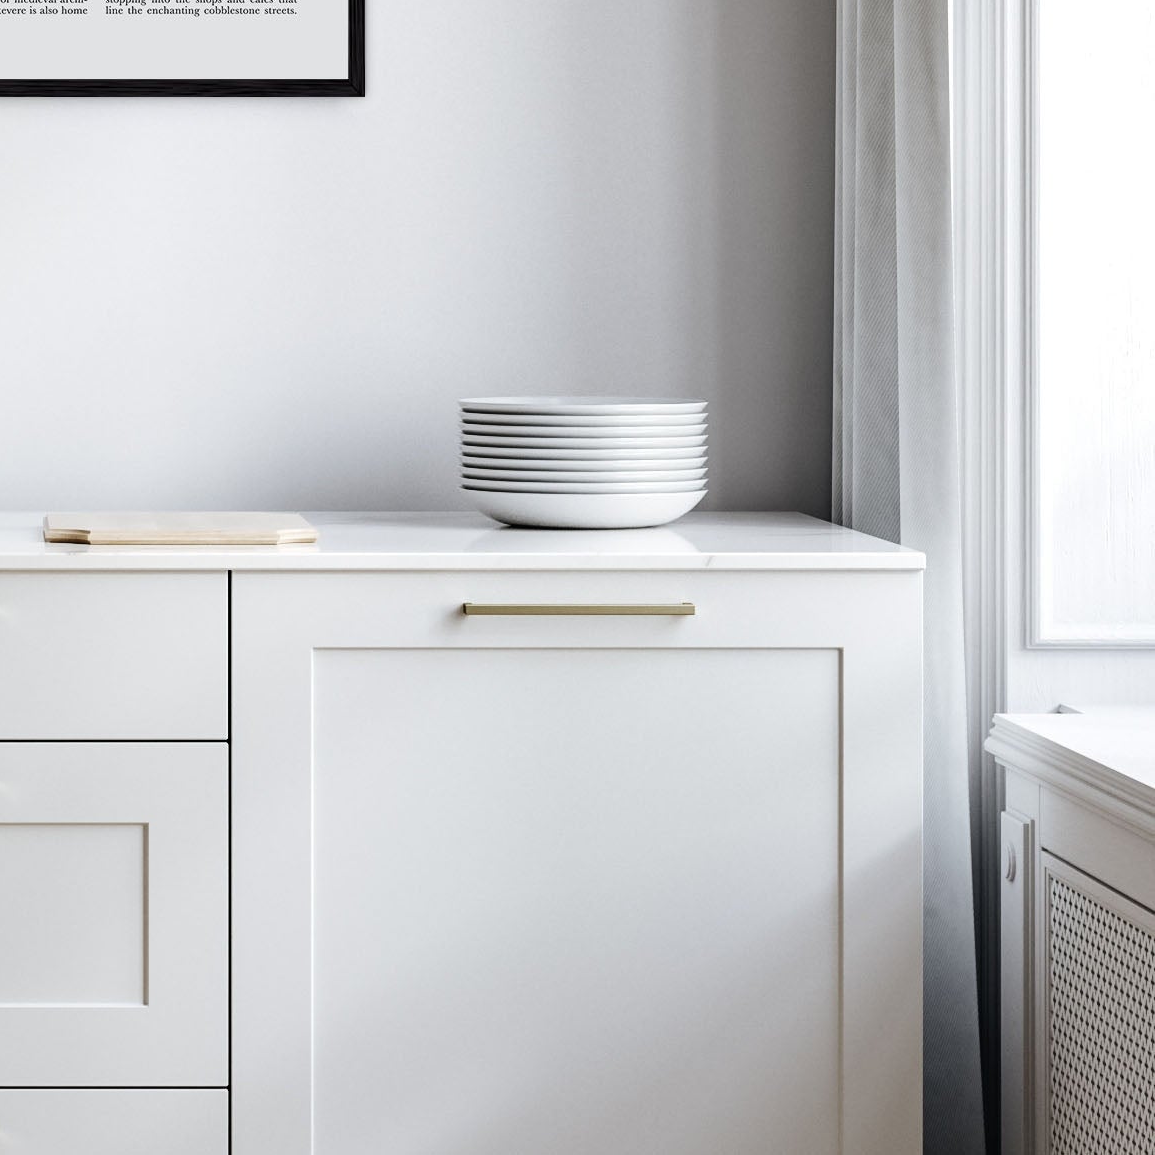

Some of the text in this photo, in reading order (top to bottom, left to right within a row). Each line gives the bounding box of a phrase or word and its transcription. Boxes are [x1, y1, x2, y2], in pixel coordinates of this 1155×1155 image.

[106, 5, 297, 16] line the enchanting cobblestone streets.
